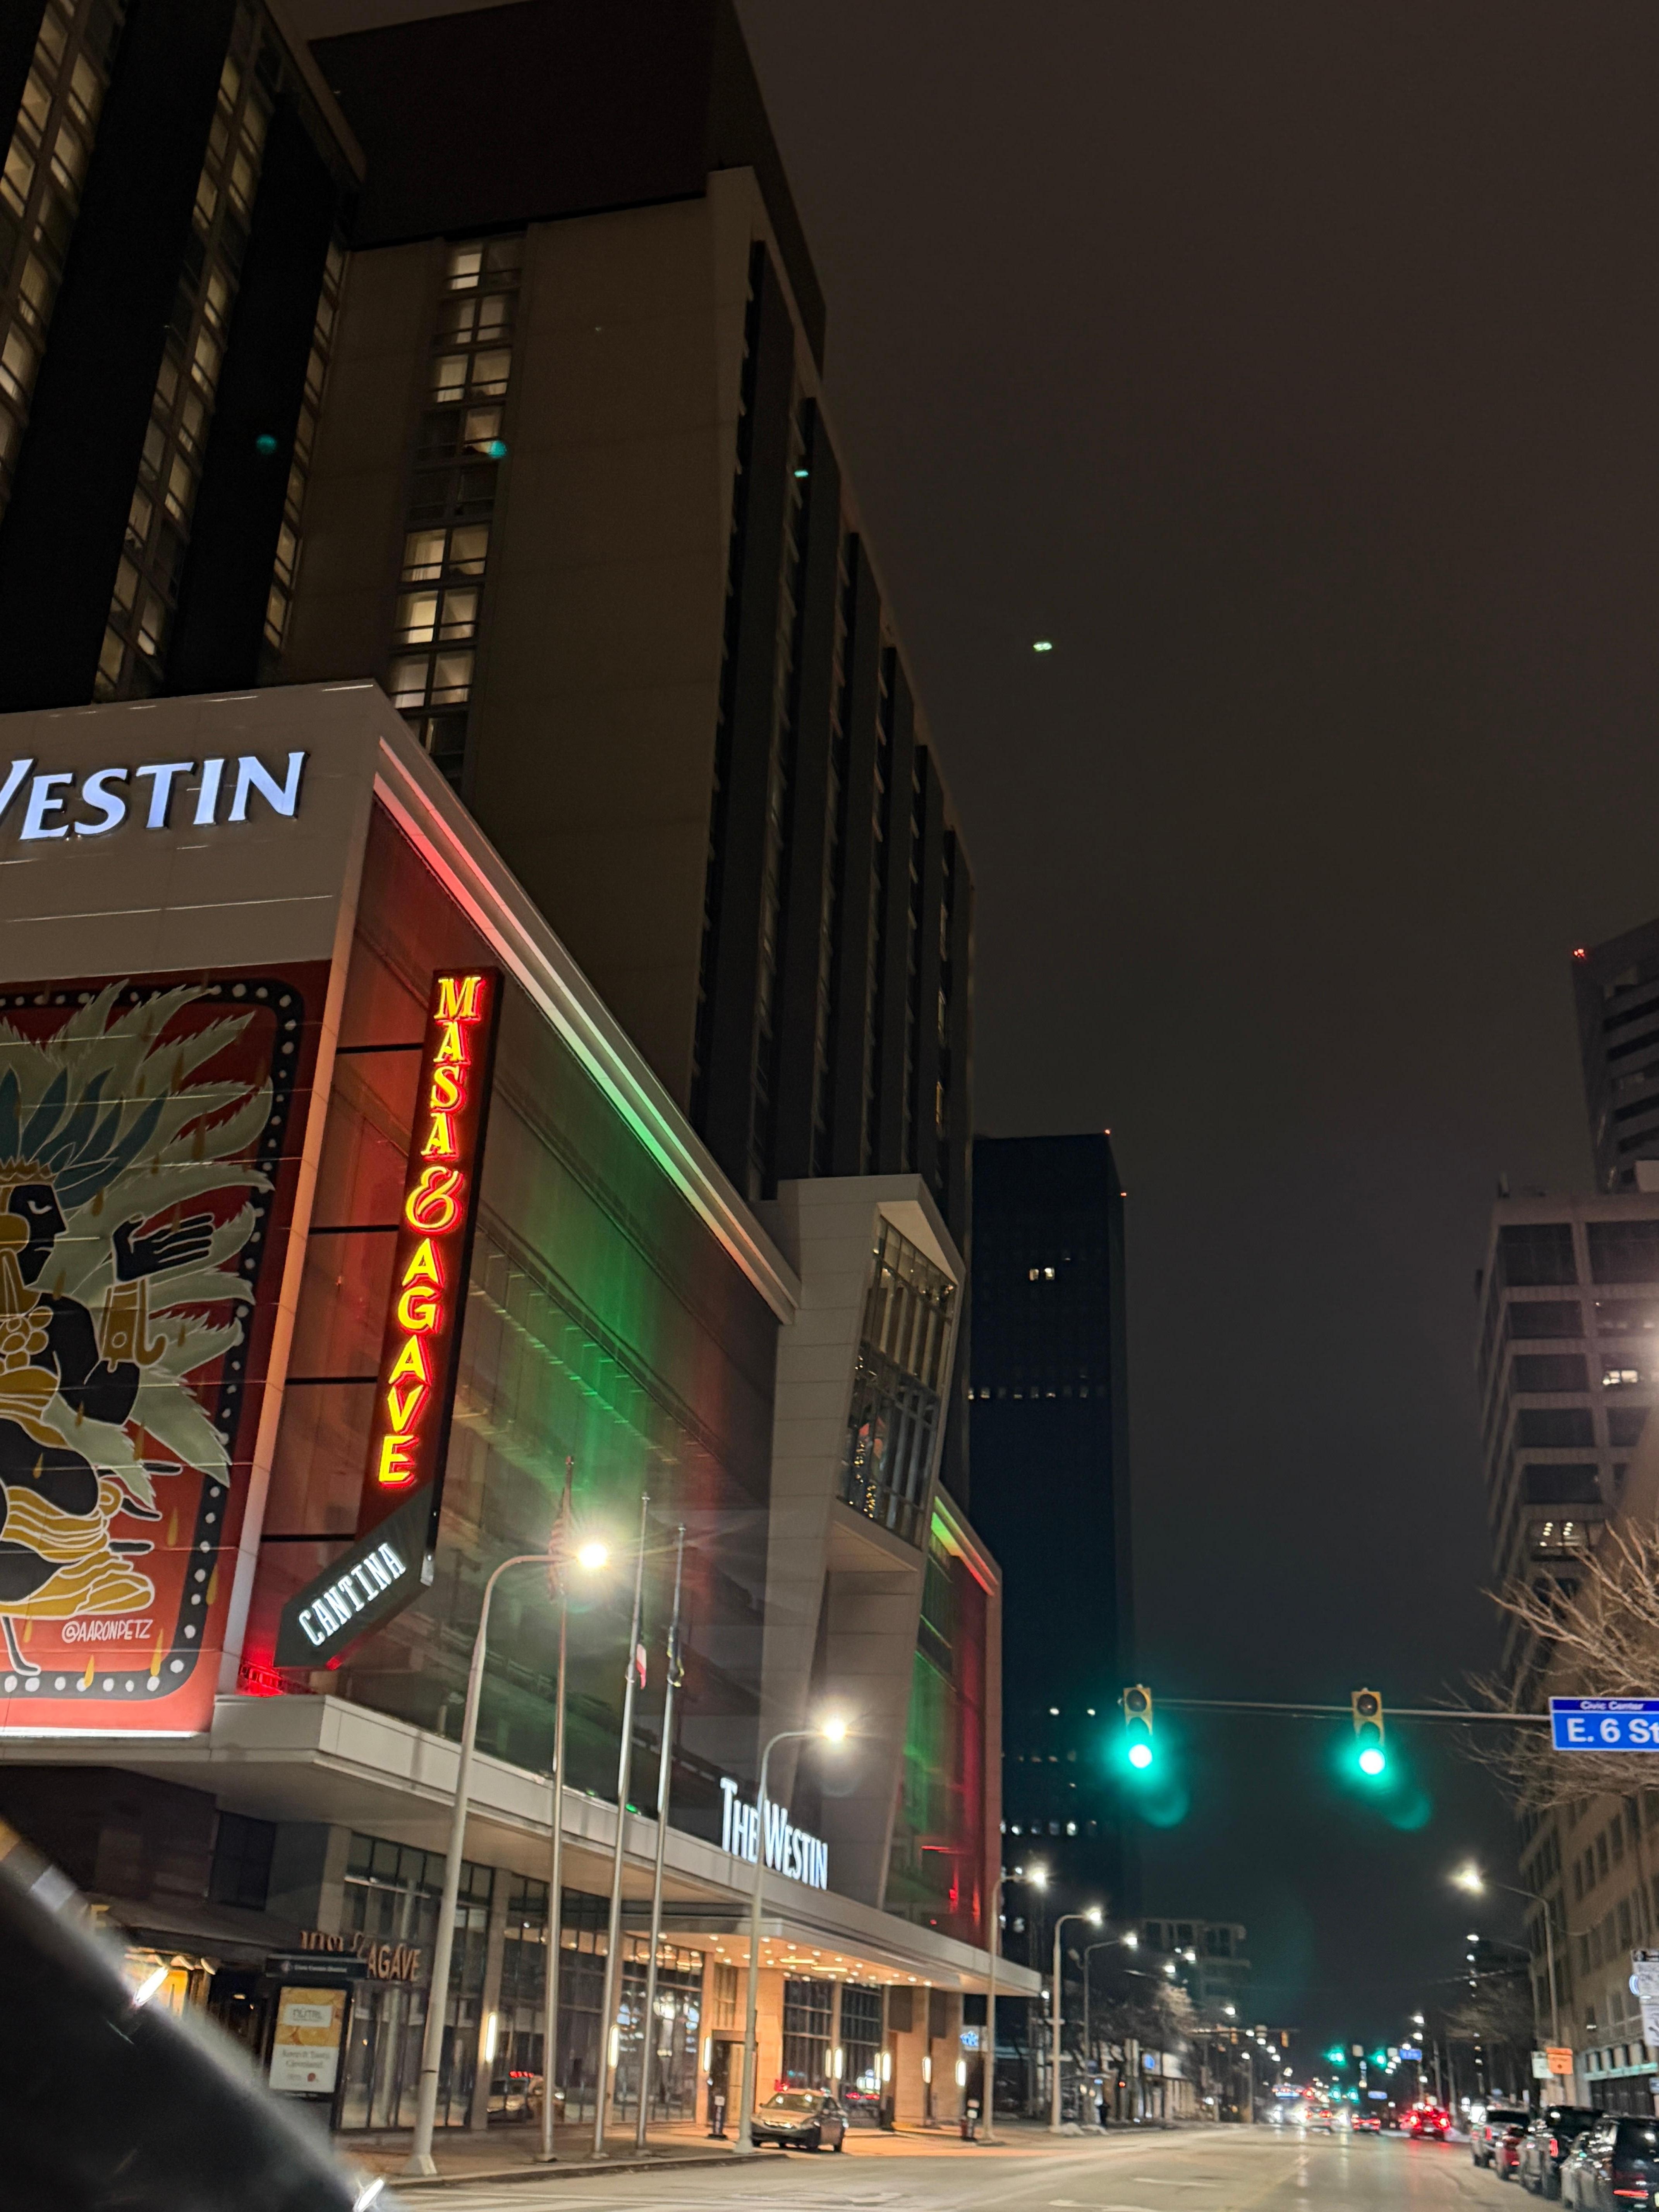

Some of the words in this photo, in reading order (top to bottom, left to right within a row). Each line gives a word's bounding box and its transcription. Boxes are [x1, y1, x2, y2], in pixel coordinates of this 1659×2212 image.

[421, 976, 485, 1160] MASA
[405, 1165, 464, 1235] &
[378, 1237, 444, 1489] AGAVE
[298, 1542, 406, 1646] CANTINA
[62, 1619, 153, 1643] @AARONPETZ
[1567, 1718, 1594, 1742] E.
[1600, 1718, 1620, 1743] 6
[368, 1941, 421, 1982] AGAVE
